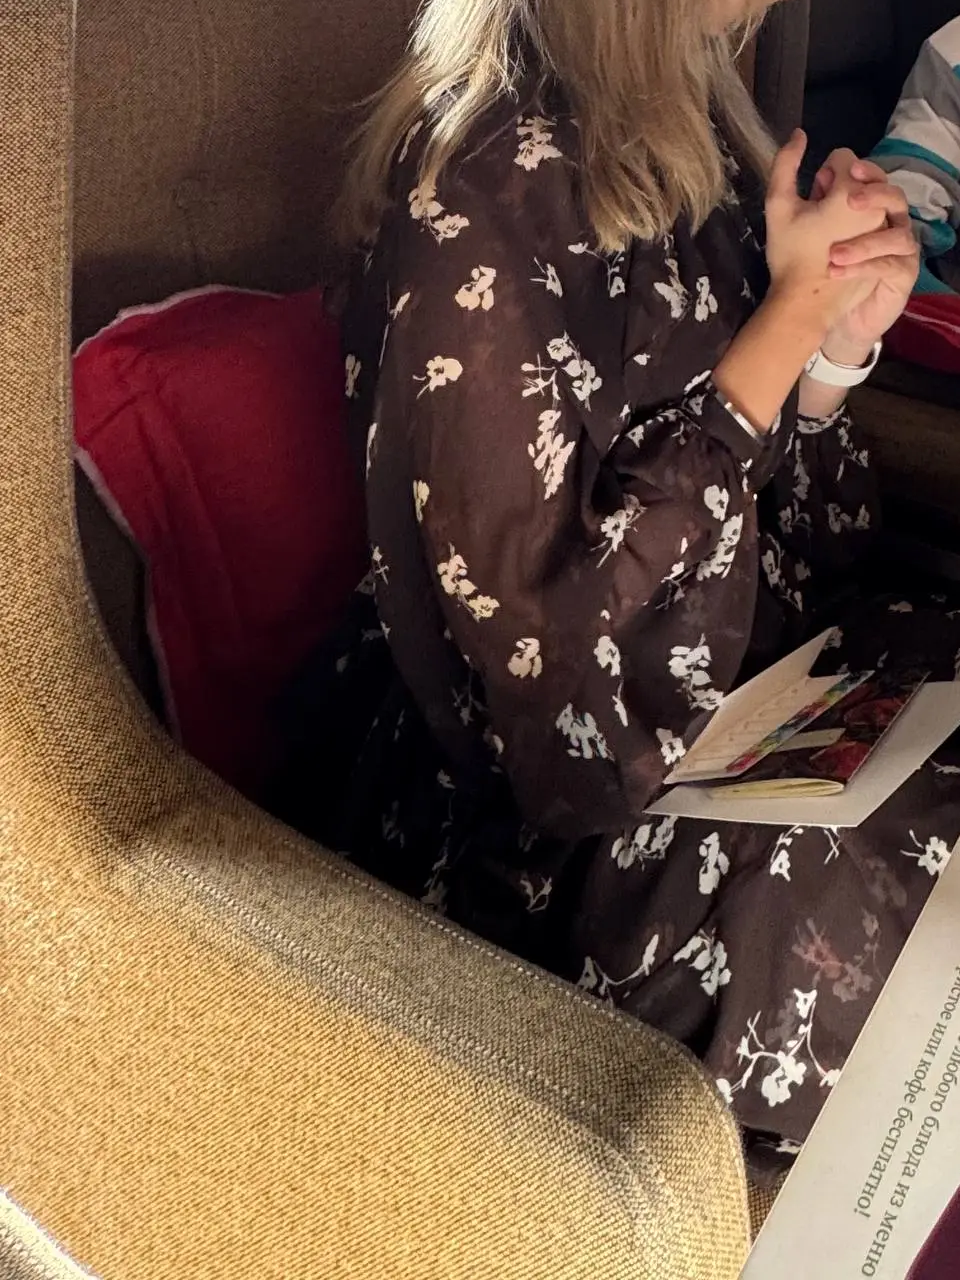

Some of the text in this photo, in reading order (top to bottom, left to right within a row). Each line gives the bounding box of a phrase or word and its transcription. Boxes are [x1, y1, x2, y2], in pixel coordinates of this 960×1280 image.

[923, 1022, 948, 1056] или
[904, 1058, 932, 1104] кофе
[854, 1107, 913, 1219] бесплатно!
[902, 1116, 939, 1178] блюда
[890, 1182, 910, 1208] из
[861, 1212, 898, 1278] меню
